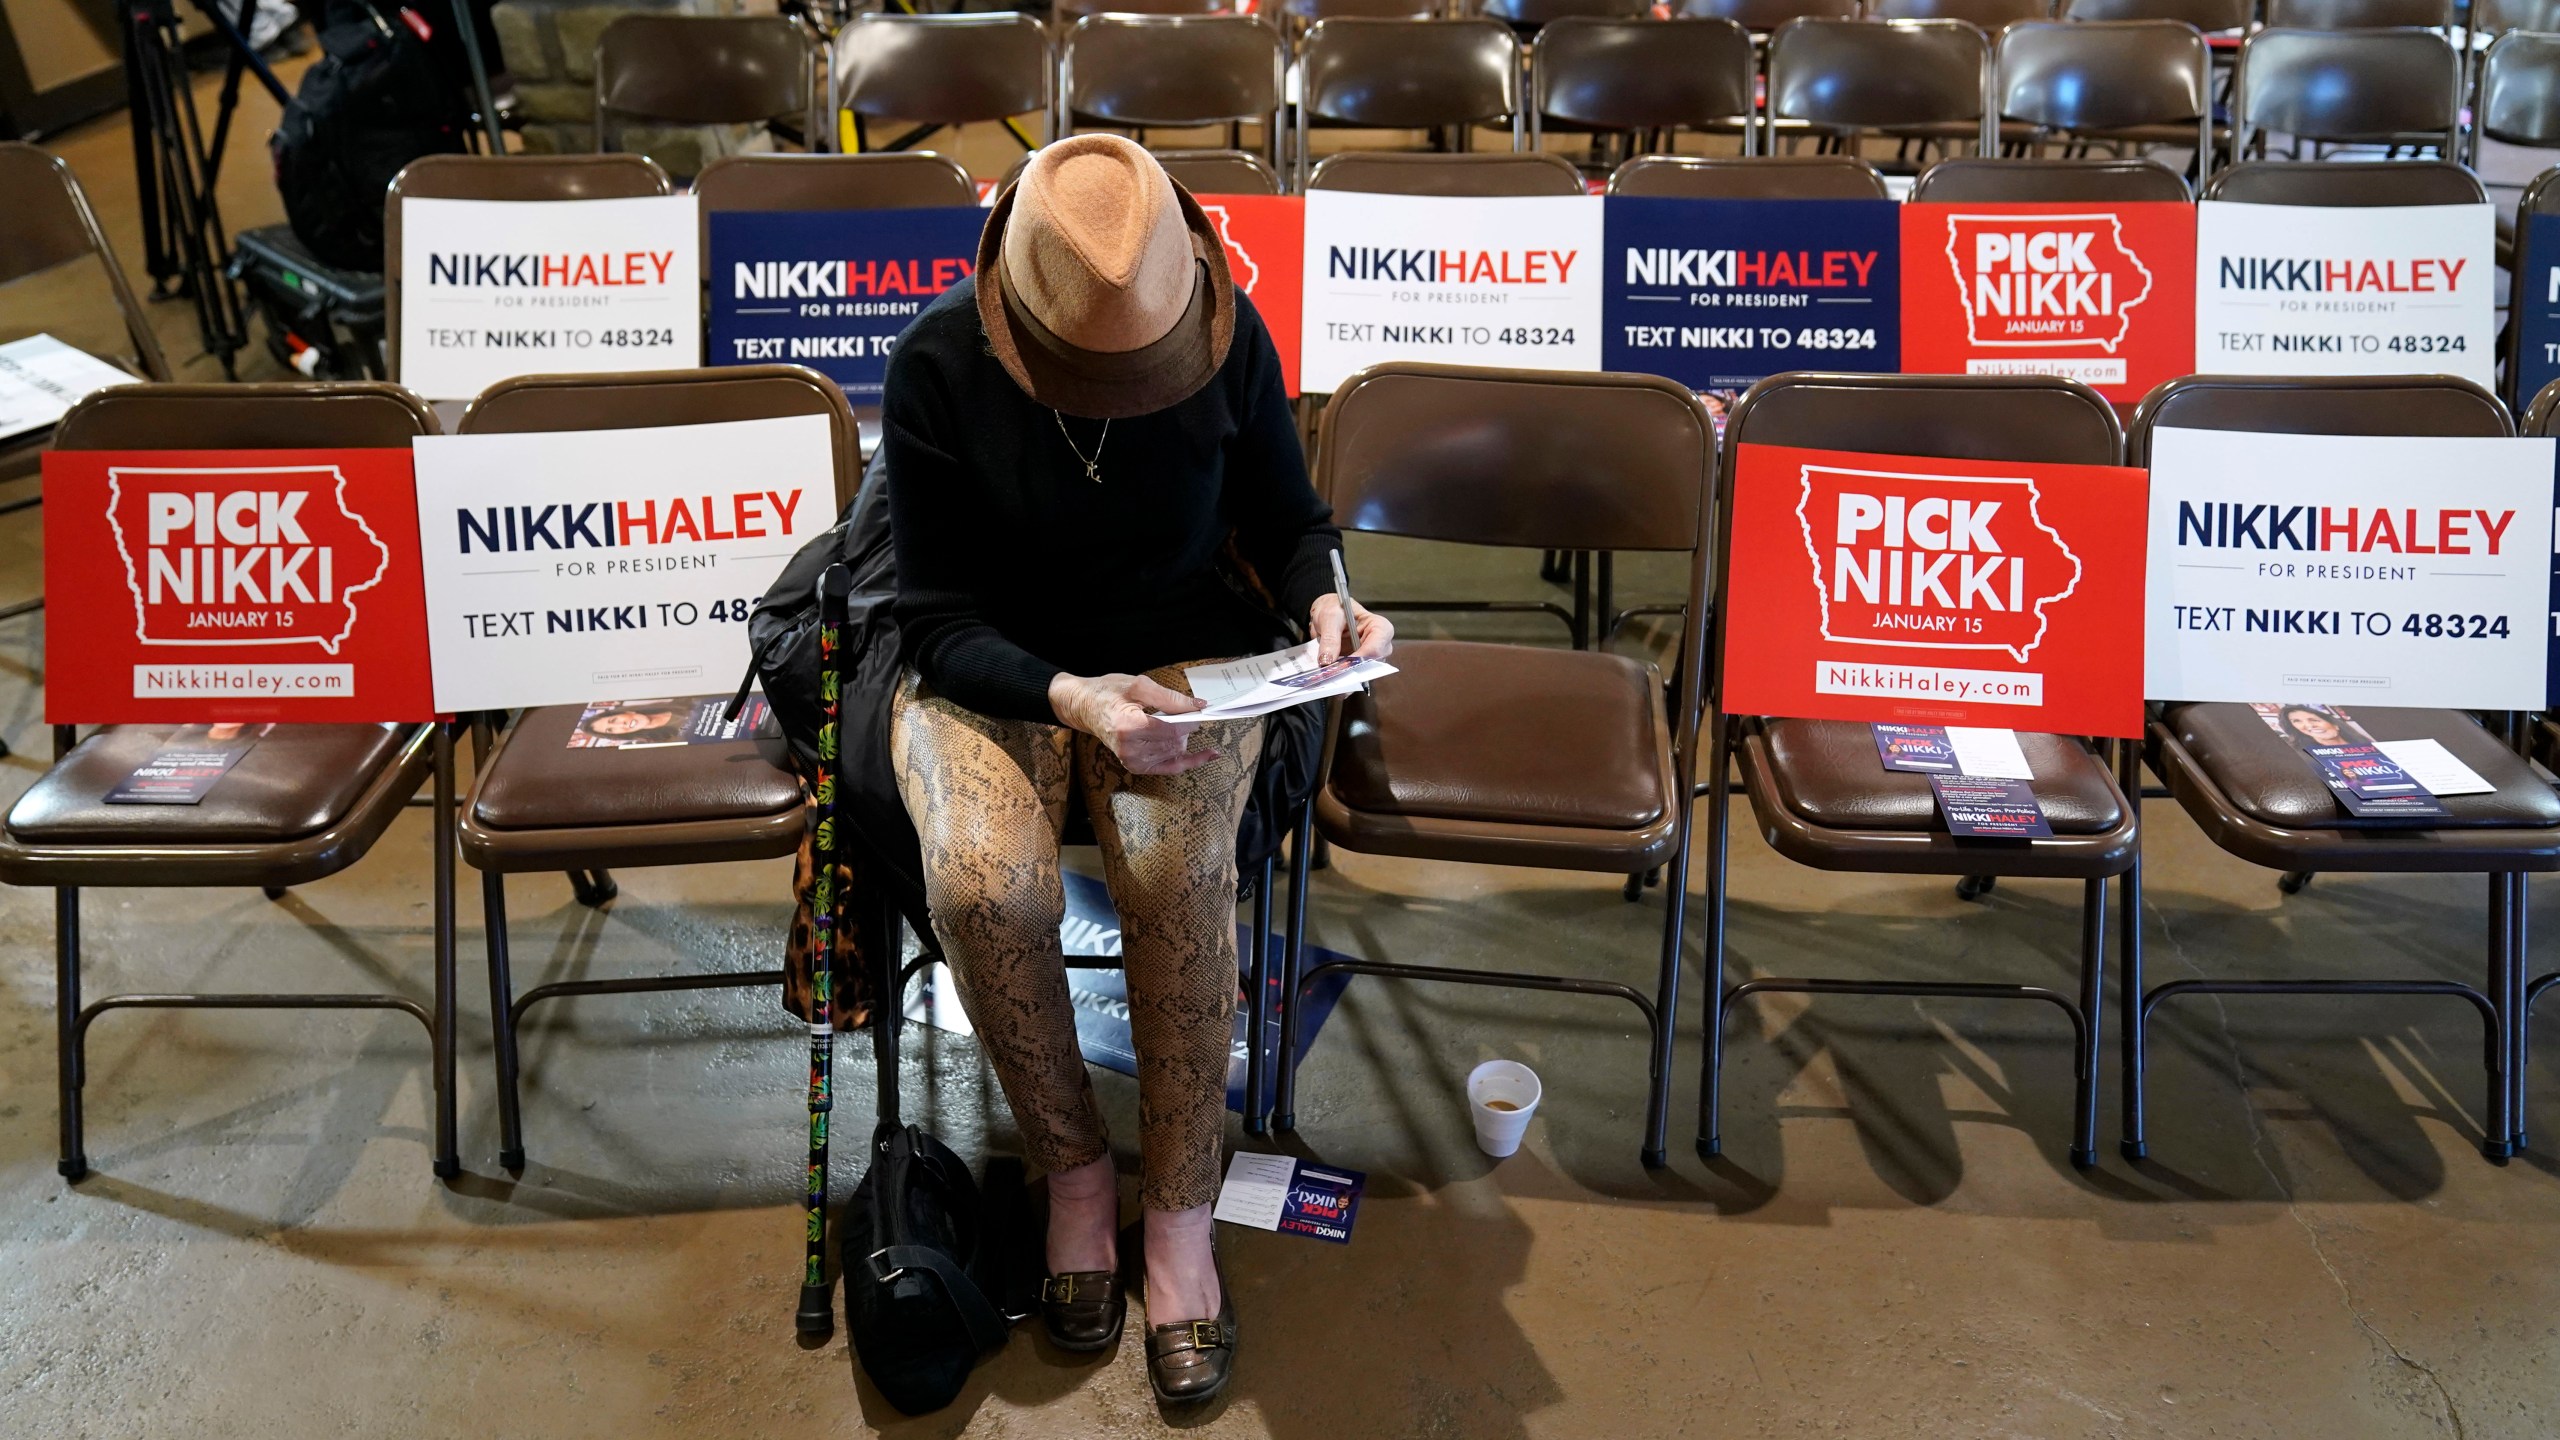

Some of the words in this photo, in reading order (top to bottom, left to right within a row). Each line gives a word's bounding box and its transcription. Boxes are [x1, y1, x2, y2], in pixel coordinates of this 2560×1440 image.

[1976, 232, 2097, 273] PICK
[430, 251, 674, 287] NIKKIHALEY
[1329, 245, 1578, 284] NIKKIHALEY
[1627, 248, 1878, 287] NIKKIHALEY
[2220, 256, 2467, 293] NIKKIHALEY
[494, 296, 524, 308] FOR
[531, 295, 611, 308] PRESIDENT
[1392, 291, 1422, 303] FOR
[1428, 292, 1509, 304] PRESIDENT
[1690, 293, 1721, 307] FOR
[1726, 293, 1809, 307] PRESIDENT
[1976, 273, 2113, 317] NIKKI
[2280, 300, 2308, 313] FOR
[2315, 301, 2396, 313] PRESIDENT
[800, 303, 831, 317] FOR
[836, 302, 920, 317] PRESIDENT
[427, 329, 478, 348] TEXT
[486, 330, 556, 348] NIKKI
[563, 330, 593, 348] TO
[600, 329, 674, 347] 48324
[1326, 323, 1376, 343] TEXT
[1383, 325, 1453, 344] NIKKI
[1461, 326, 1491, 345] TO
[1499, 327, 1576, 346] 48324
[1624, 326, 1676, 348] TEXT
[1681, 327, 1754, 349] NIKKI
[1759, 328, 1792, 349] TO
[1796, 328, 1877, 350] 48324
[2005, 320, 2066, 334] JANUARY
[2070, 320, 2084, 333] 15
[733, 338, 786, 359] TEXT
[790, 337, 864, 358] NIKKI
[2219, 332, 2265, 352] TEXT
[2273, 334, 2342, 353] NIKKI
[2350, 335, 2380, 354] TO
[2388, 336, 2467, 354] 48324
[148, 490, 312, 546] PICK
[457, 488, 803, 554] NIKKIHALEY
[1836, 492, 2003, 553] PICK
[2179, 500, 2516, 555] NIKKIHALEY
[148, 546, 333, 604] NIKKI
[556, 561, 597, 577] FOR
[607, 554, 718, 574] PRESIDENT
[2259, 563, 2296, 577] FOR
[2307, 564, 2416, 581] PRESIDENT
[1834, 547, 2024, 613] NIKKI
[187, 611, 269, 628] JANUARY
[275, 611, 294, 627] 15
[463, 611, 535, 639] TEXT
[546, 605, 647, 634] NIKKI
[656, 602, 699, 627] TO
[1872, 613, 1956, 632] JANUARY
[1964, 617, 1983, 633] 15
[2174, 606, 2236, 631] TEXT
[2245, 608, 2339, 635] NIKKI
[2351, 612, 2391, 636] TO
[2402, 613, 2511, 639] 48324
[147, 669, 342, 694] NikkiHaley.com
[1830, 668, 2031, 699] NikkiHaley.com
[1894, 738, 1933, 747] PICK
[1951, 813, 2036, 823] NIKKIHALEY
[1301, 1203, 1338, 1218] PICK
[1281, 1220, 1346, 1239] NIKKIHALEY
